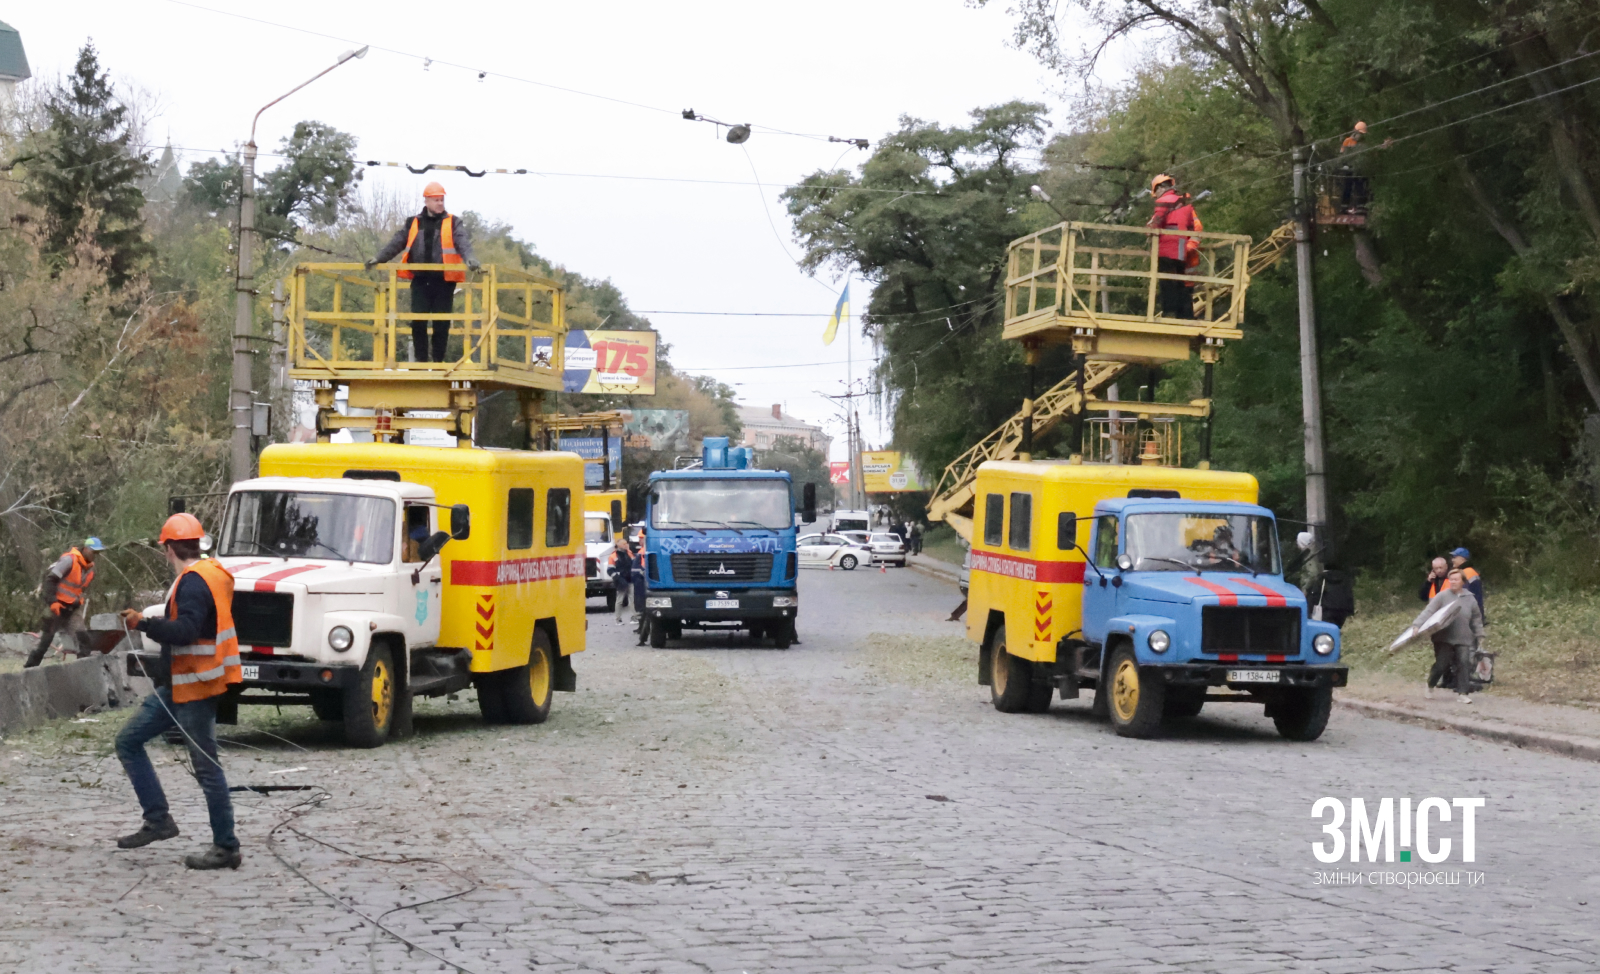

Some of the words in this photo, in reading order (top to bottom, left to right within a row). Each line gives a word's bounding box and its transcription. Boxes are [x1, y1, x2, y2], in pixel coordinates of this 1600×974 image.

[592, 340, 649, 377] 175
[243, 668, 258, 677] AH
[1231, 671, 1242, 680] BI
[1246, 672, 1264, 681] 1384
[1266, 672, 1279, 680] AH
